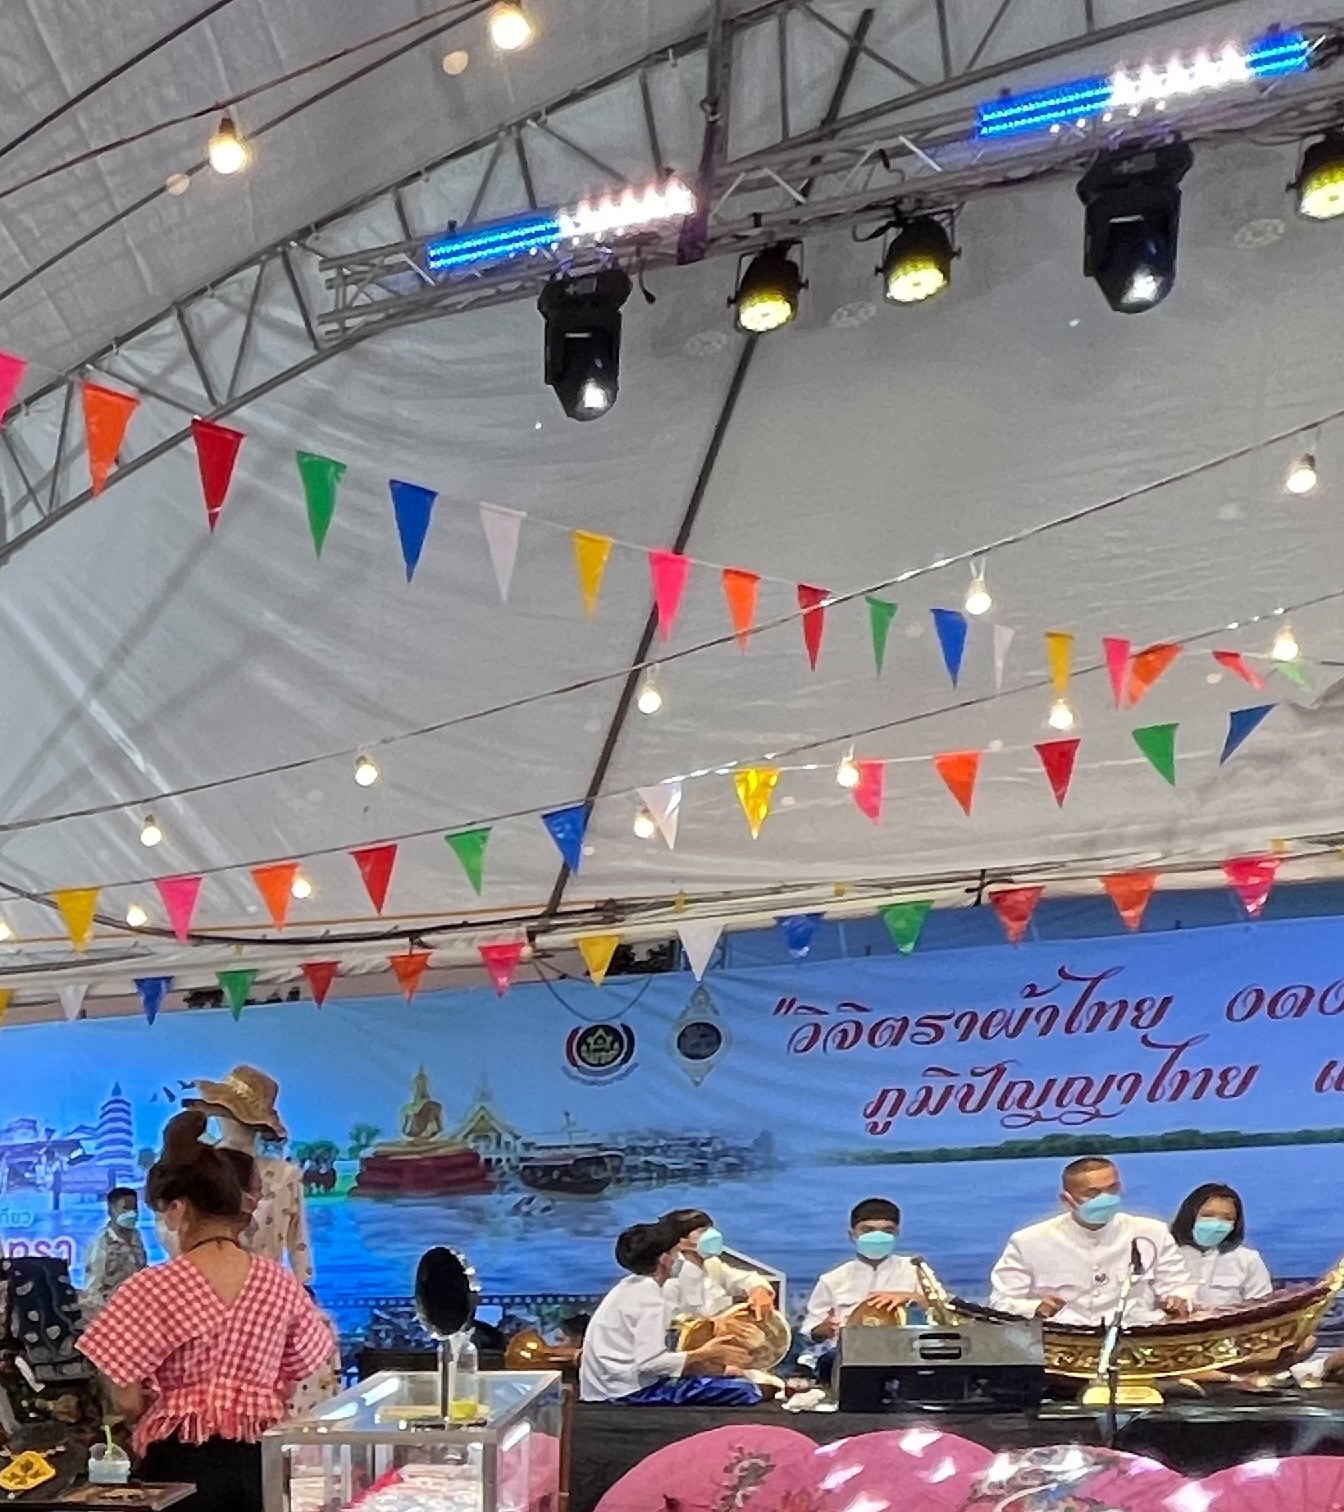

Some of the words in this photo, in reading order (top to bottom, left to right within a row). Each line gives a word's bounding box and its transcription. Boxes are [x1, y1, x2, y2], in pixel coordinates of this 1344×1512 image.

[862, 1032, 1261, 1136] ภูมิปัญญาไทย
